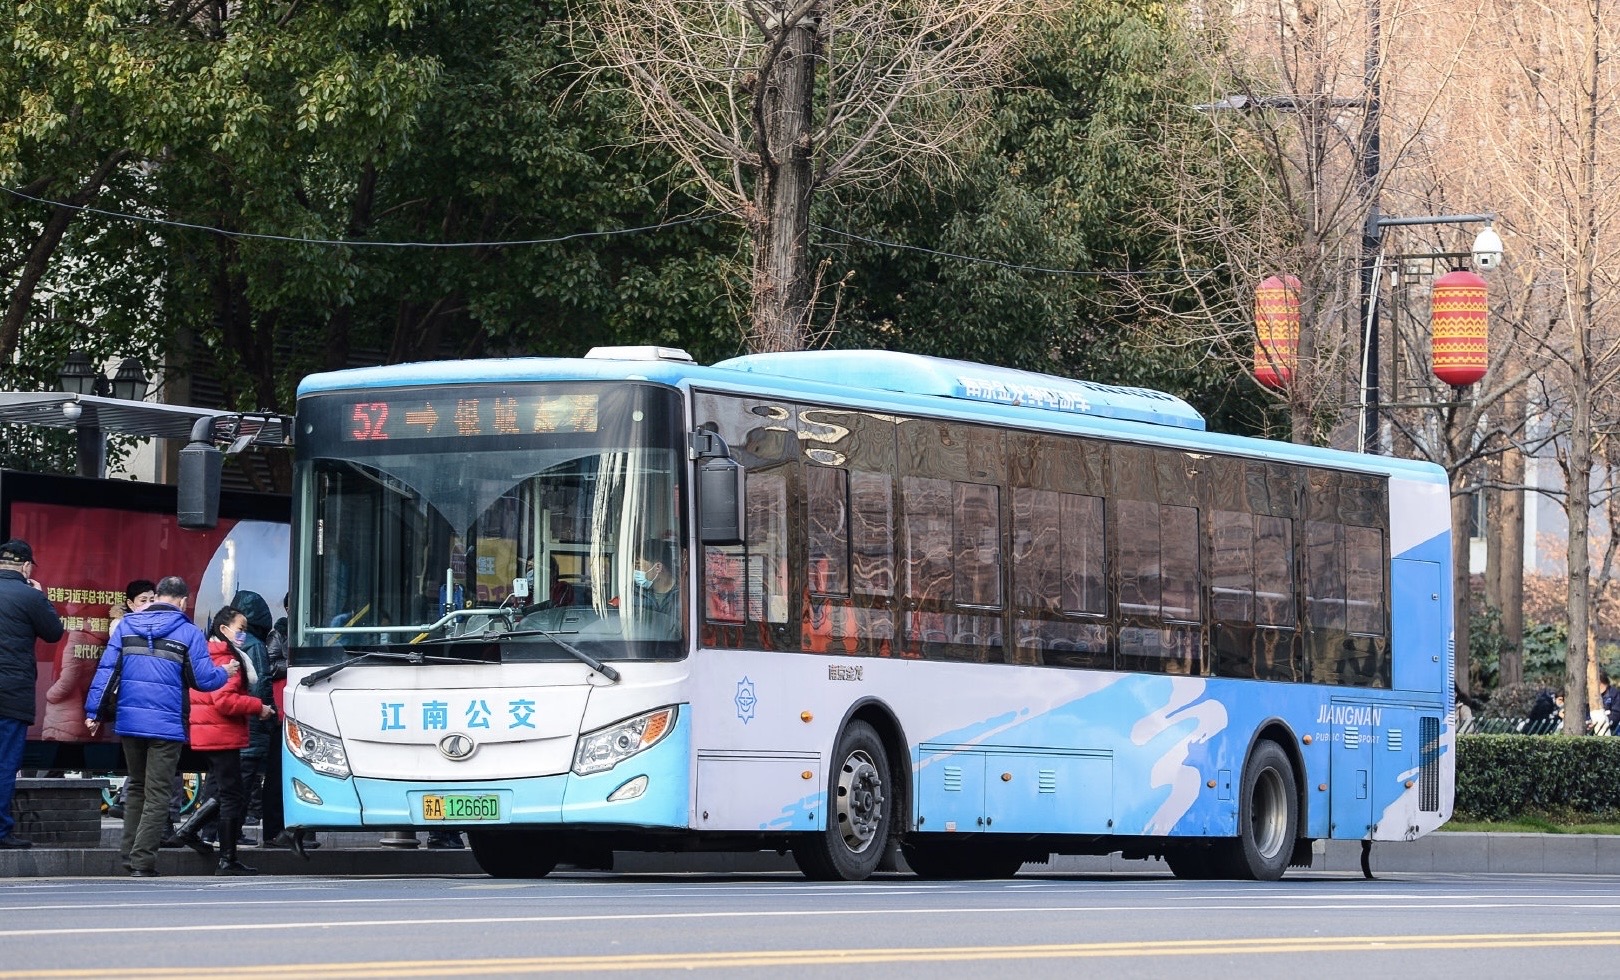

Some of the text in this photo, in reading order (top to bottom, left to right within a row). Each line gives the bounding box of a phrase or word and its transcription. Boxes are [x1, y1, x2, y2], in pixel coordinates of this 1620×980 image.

[353, 402, 389, 440] 52
[381, 699, 536, 731] 江南公交
[1316, 704, 1382, 727] JIANGNAN
